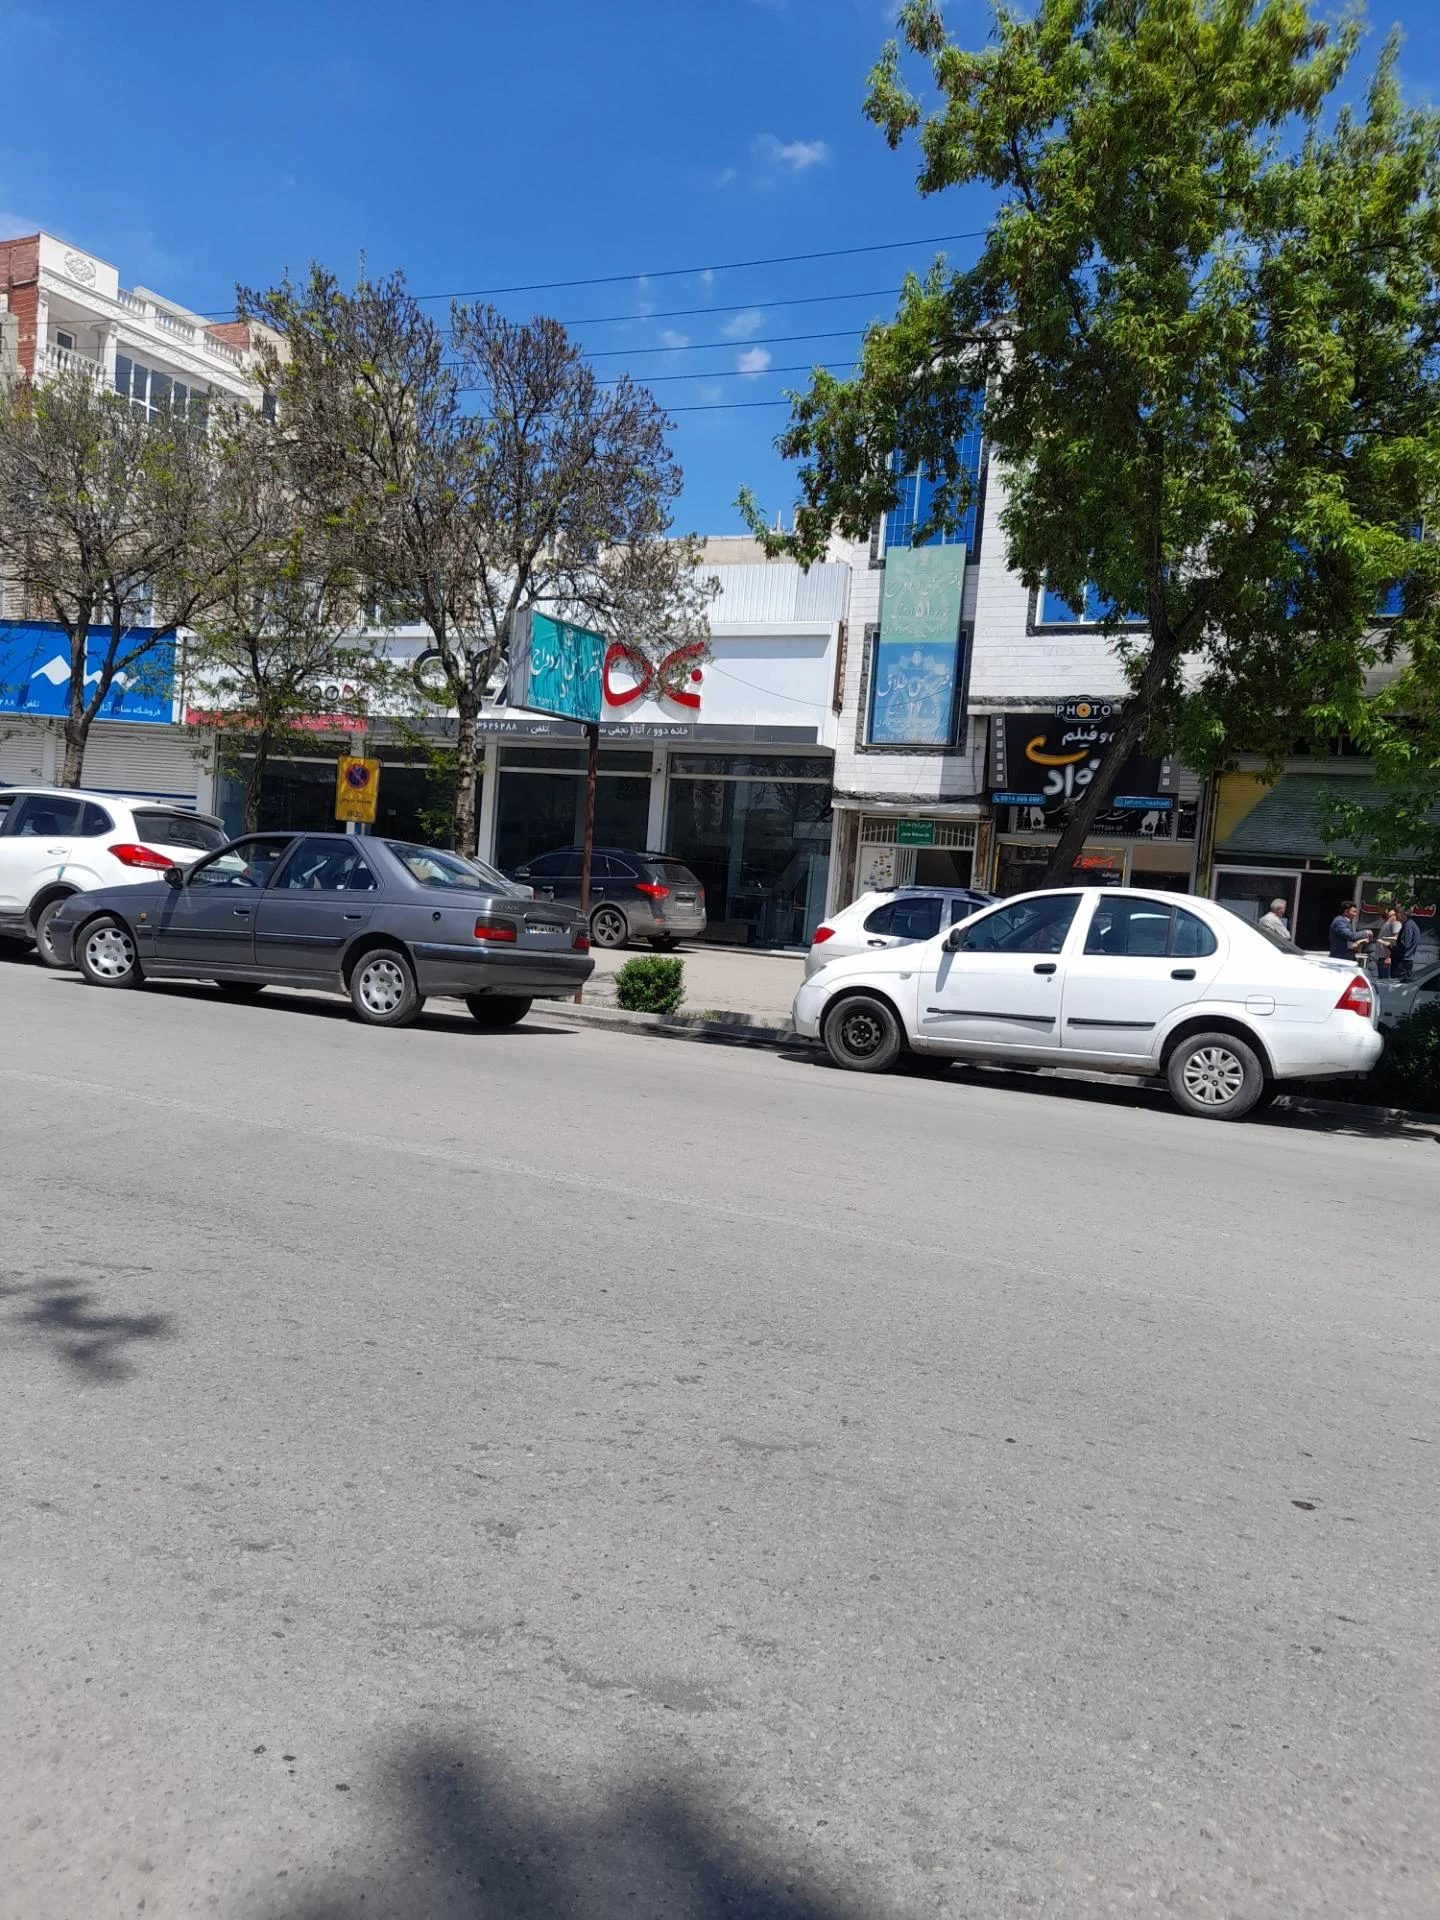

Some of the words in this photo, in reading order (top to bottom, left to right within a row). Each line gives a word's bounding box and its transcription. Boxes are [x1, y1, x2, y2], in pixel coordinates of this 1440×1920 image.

[133, 705, 161, 717] فروشگاه
[1056, 702, 1111, 718] PHOTO
[653, 728, 669, 736] دوو
[671, 727, 688, 735] خانه
